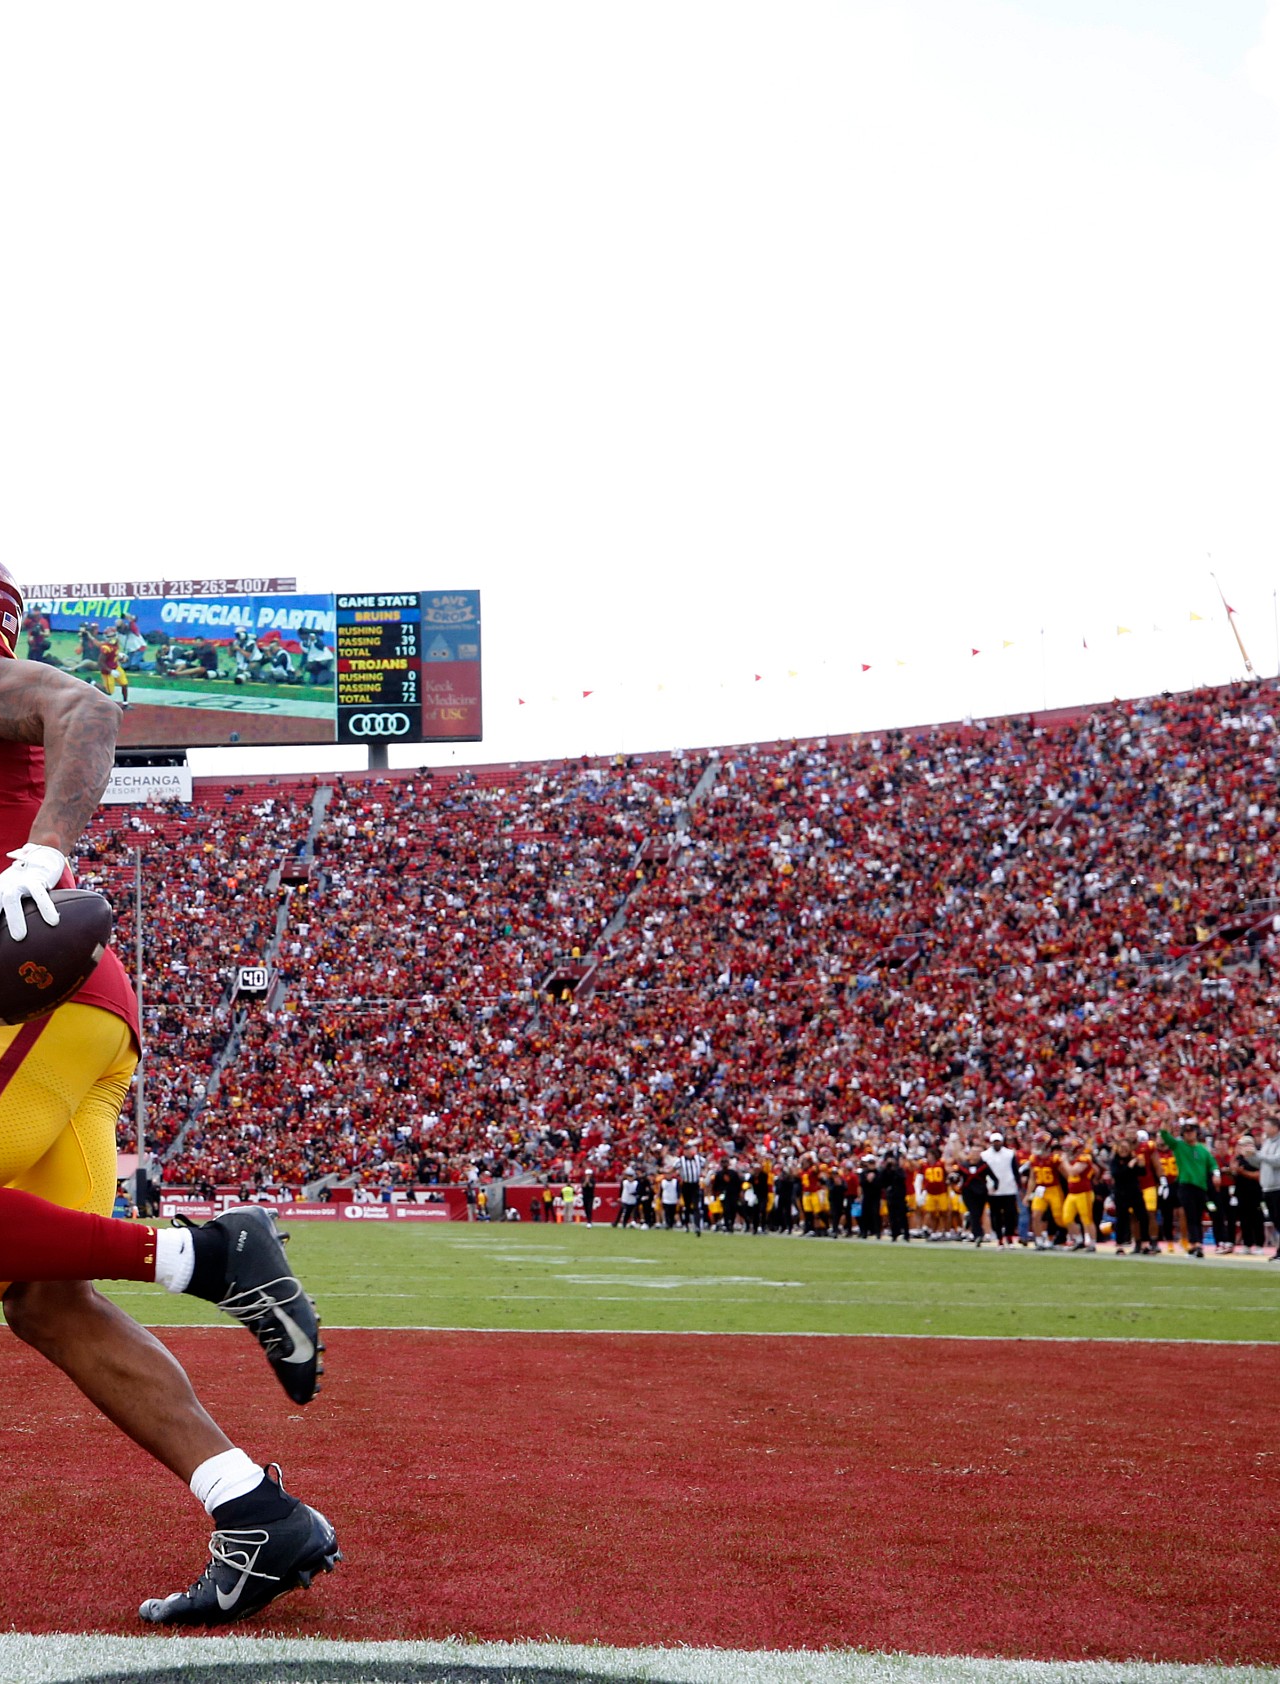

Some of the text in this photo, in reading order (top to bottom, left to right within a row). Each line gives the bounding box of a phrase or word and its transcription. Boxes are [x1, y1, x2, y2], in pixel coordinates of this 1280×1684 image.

[72, 583, 105, 597] CALL
[109, 582, 127, 596] OR
[131, 582, 165, 595] TEXT
[338, 595, 417, 608] GAME STATS
[432, 595, 468, 607] SAVE
[161, 602, 253, 627] OFFICIAL
[355, 611, 401, 622] BRUINS
[433, 610, 468, 622] DROP
[338, 626, 383, 636] RUSHING
[401, 625, 414, 634] 71
[338, 636, 415, 646] PASSING 39
[339, 646, 416, 657] TOTAL 110
[349, 659, 408, 670] TROJANS
[339, 673, 384, 682] RUSHING
[339, 682, 416, 692] PASSING 72
[339, 693, 417, 703] TOTAL 72
[426, 693, 477, 706] Medicine
[440, 708, 468, 720] USC
[243, 971, 264, 986] 40
